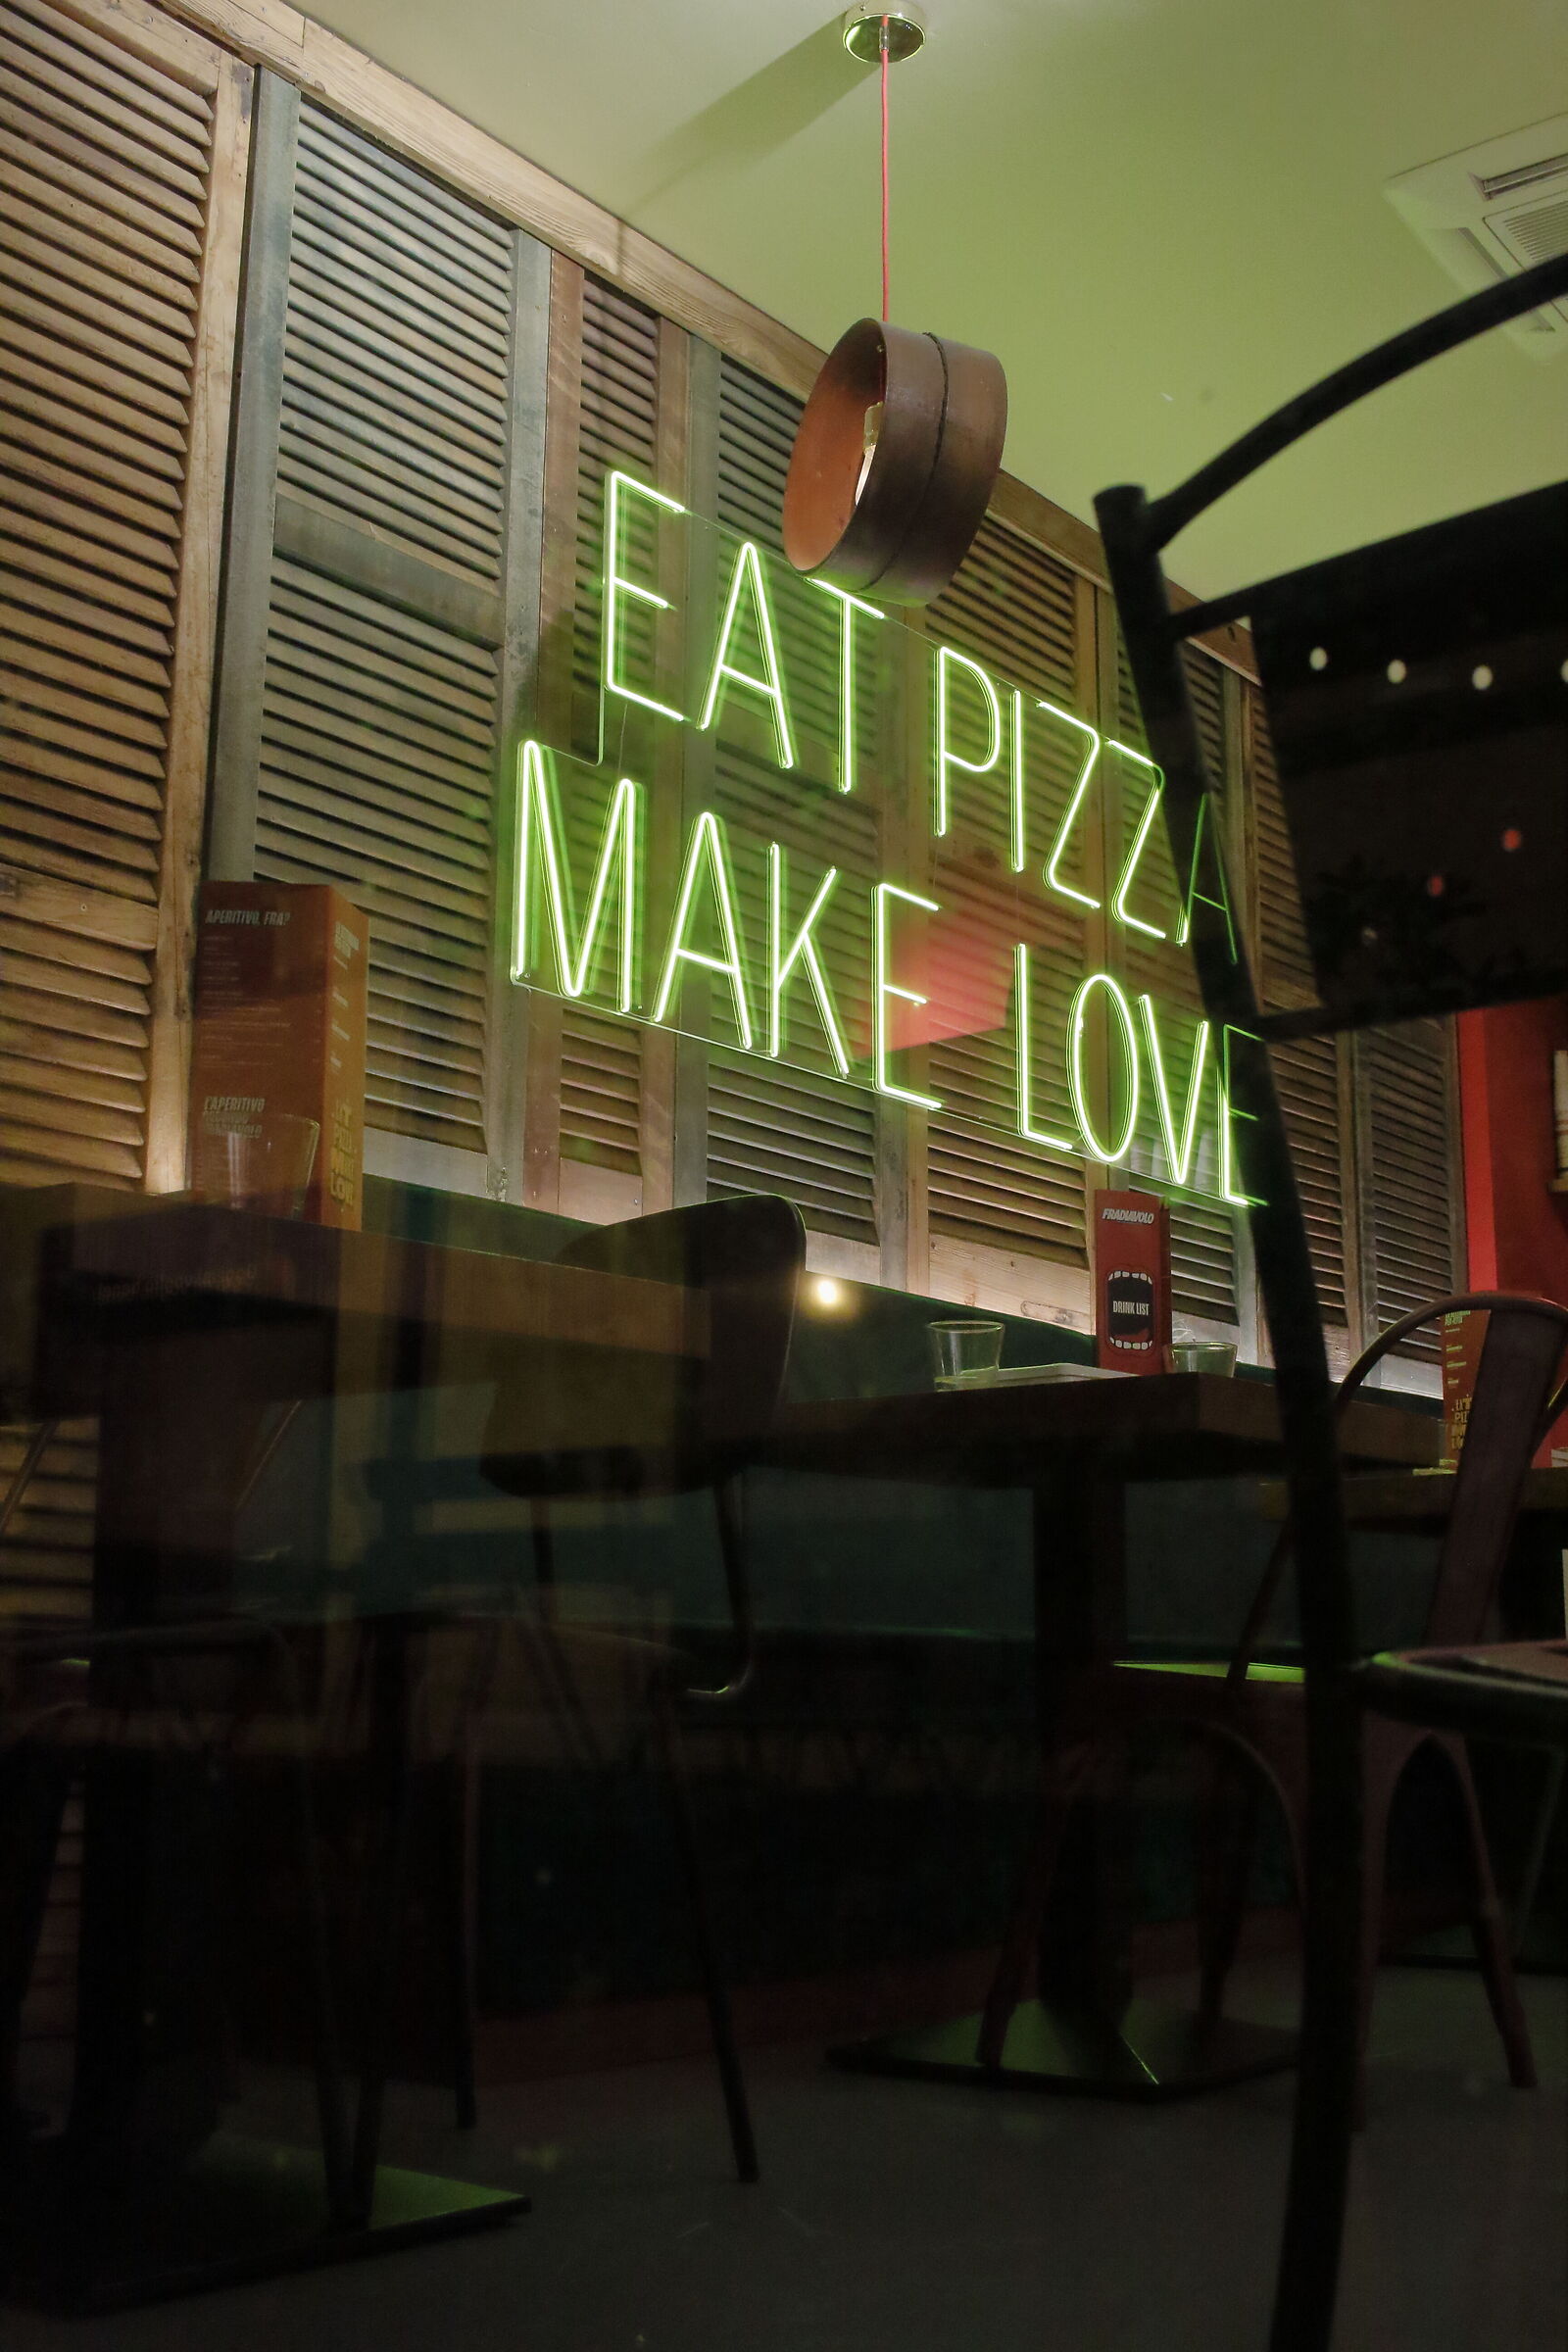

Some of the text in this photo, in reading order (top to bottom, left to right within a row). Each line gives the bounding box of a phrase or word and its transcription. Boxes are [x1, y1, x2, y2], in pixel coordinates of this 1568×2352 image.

[604, 470, 1239, 966] EAT PIZZA
[513, 739, 1270, 1207] MAKE LOVE
[1102, 1207, 1154, 1225] FRADIAVOLO
[1112, 1300, 1150, 1316] DRINK LIST
